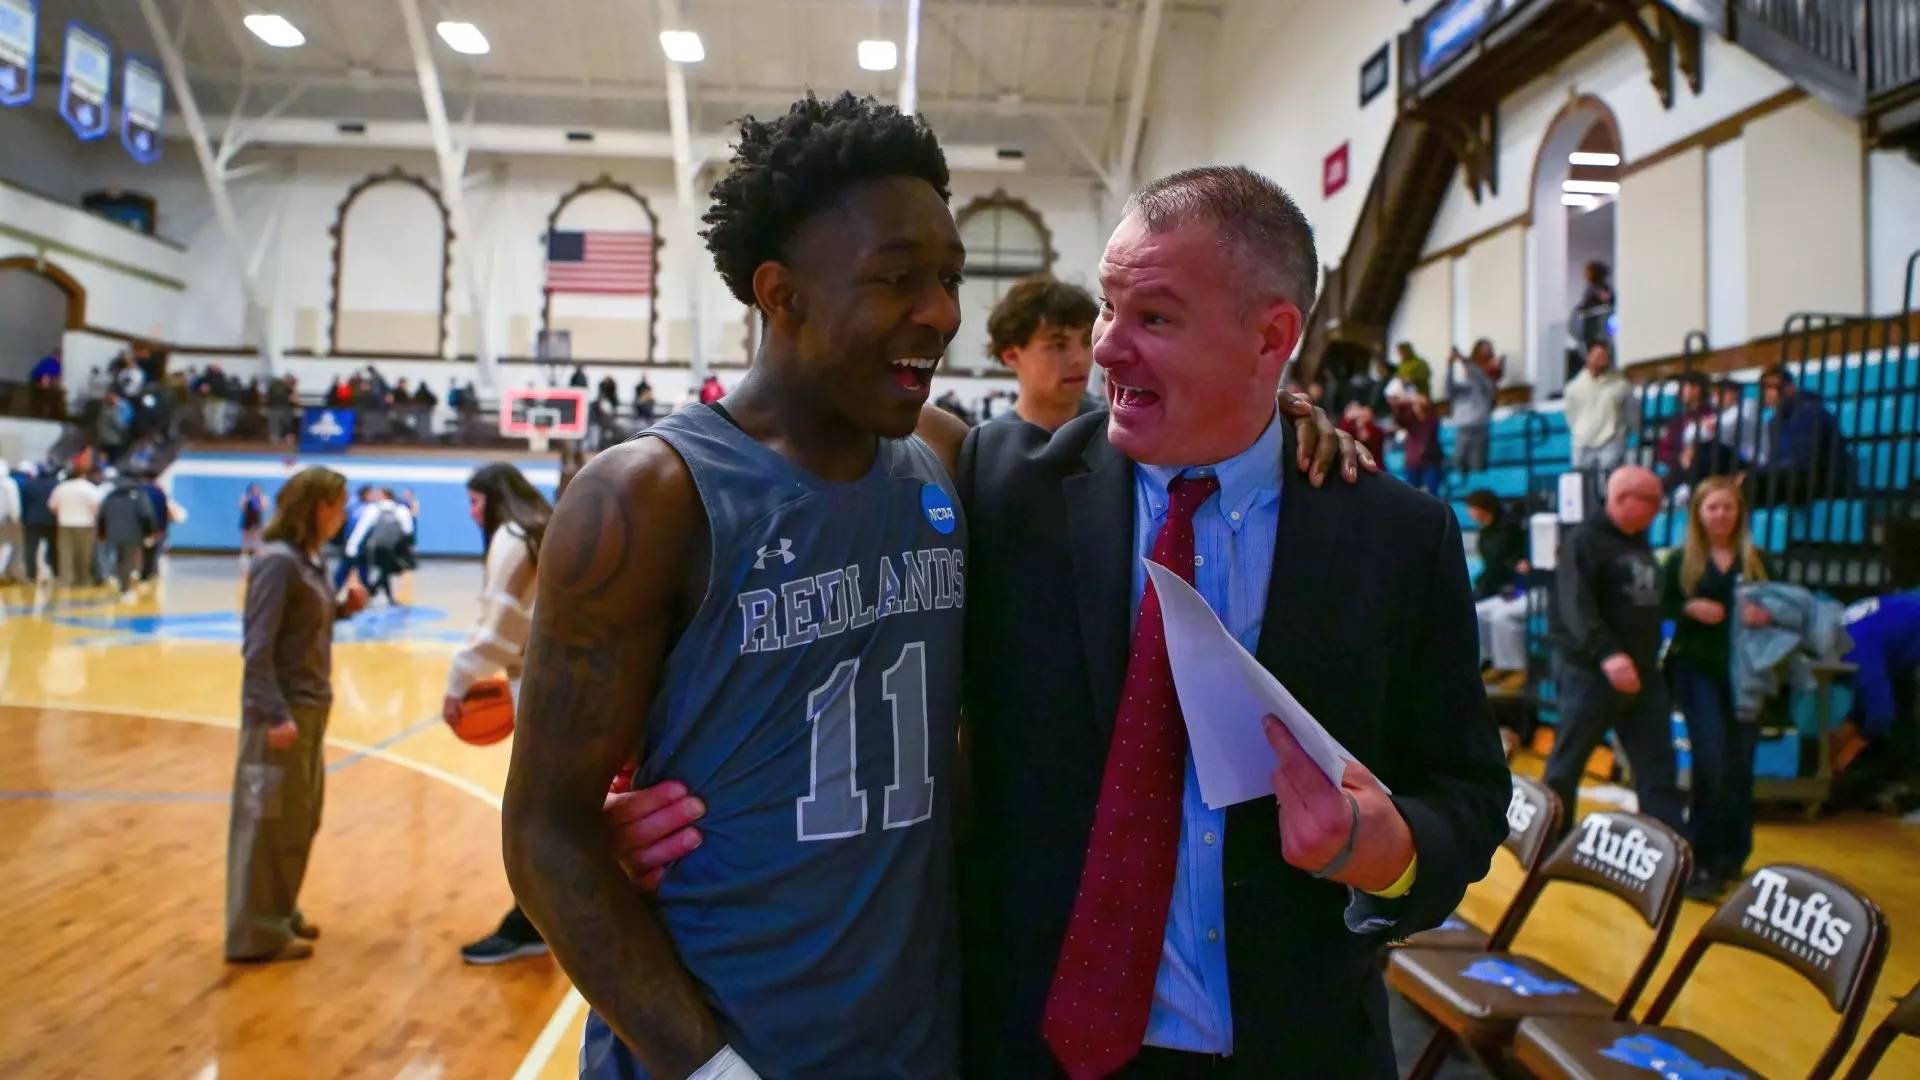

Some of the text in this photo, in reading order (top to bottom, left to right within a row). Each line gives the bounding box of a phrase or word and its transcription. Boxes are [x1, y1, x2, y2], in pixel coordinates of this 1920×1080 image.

[928, 507, 955, 521] NCAA
[737, 548, 965, 655] REDLANDS
[796, 640, 935, 842] 11
[1577, 812, 1664, 881] Tufts
[1741, 914, 1832, 971] UNIVERSITY
[1746, 868, 1853, 956] Tufts
